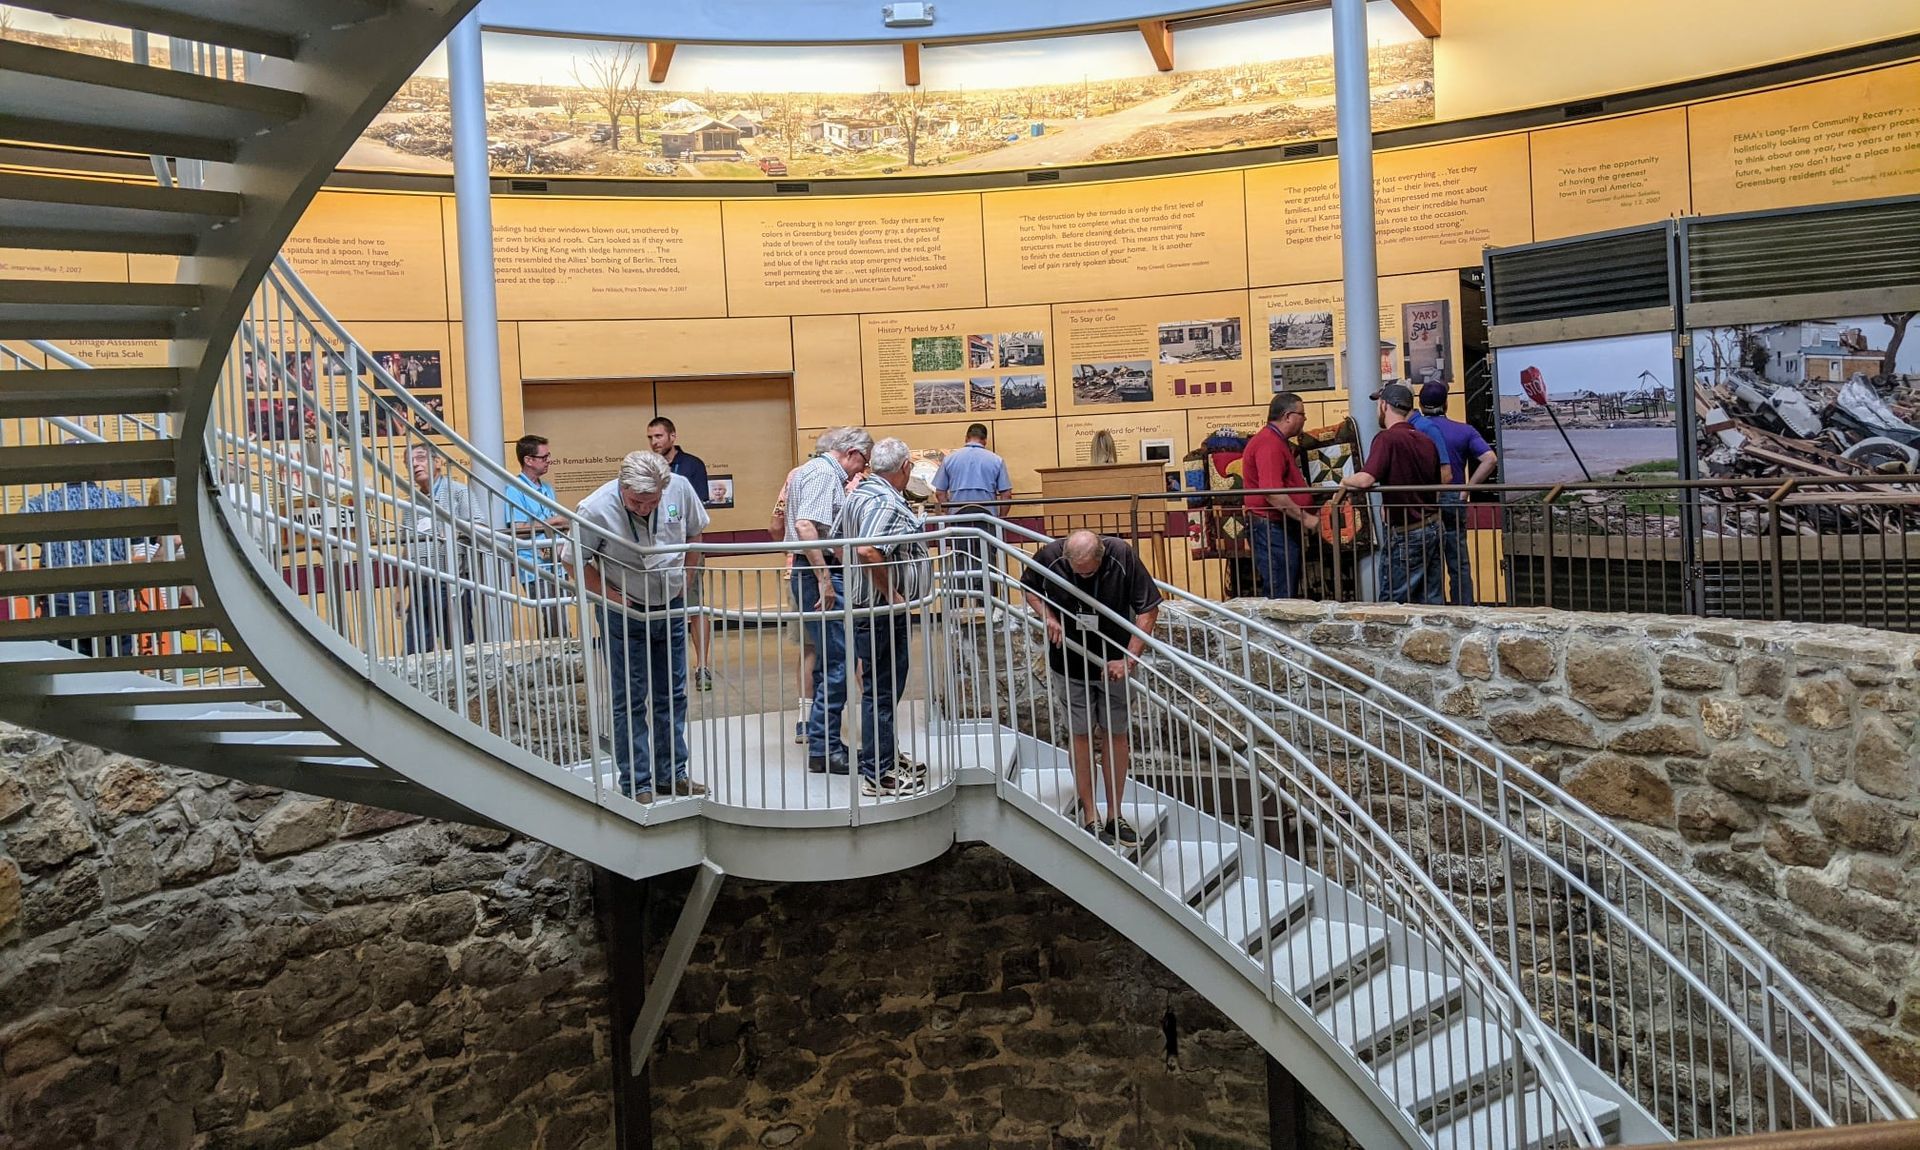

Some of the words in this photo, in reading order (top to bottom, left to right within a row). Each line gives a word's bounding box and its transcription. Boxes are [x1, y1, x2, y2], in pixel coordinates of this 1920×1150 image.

[1733, 131, 1763, 142] FEMA's
[1765, 125, 1809, 136] Long-Term
[1812, 115, 1859, 129] Community
[1863, 108, 1903, 120] Recovery
[1734, 142, 1776, 153] holistically
[1780, 137, 1810, 146] looking
[1826, 131, 1844, 140] your
[1848, 124, 1886, 135] recovery
[1890, 118, 1920, 129] proces
[1745, 155, 1764, 163] think
[1767, 151, 1792, 160] about
[1857, 137, 1882, 147] years
[1614, 157, 1659, 168] opportunity
[1789, 162, 1804, 171] you
[1807, 156, 1828, 166] don't
[1864, 148, 1889, 159] place
[1904, 143, 1920, 151] slee
[1569, 177, 1595, 185] having
[1612, 170, 1646, 181] greenest
[1735, 177, 1786, 189] Greensburg
[1789, 171, 1826, 181] residents
[1588, 185, 1607, 194] rural
[1314, 204, 1326, 212] and
[1328, 202, 1342, 210] eac
[1393, 192, 1429, 203] impressed
[1286, 237, 1313, 245] Despite
[1373, 226, 1411, 238] wnspeople
[1413, 223, 1434, 231] stood
[313, 236, 340, 244] flexible
[287, 247, 314, 255] spatula
[493, 267, 521, 275] peared
[1284, 299, 1303, 307] Love,
[1305, 297, 1331, 305] Believe,
[1080, 315, 1093, 324] Stay
[1412, 310, 1438, 321] YARD
[877, 326, 903, 334] History
[930, 324, 938, 333] by
[1412, 320, 1438, 331] SALE
[78, 350, 93, 358] the
[96, 350, 119, 359] Fujita
[121, 349, 143, 358] Scale
[1205, 420, 1260, 429] Communicating
[563, 456, 603, 464] Remarkable
[293, 511, 322, 525] MAIN
